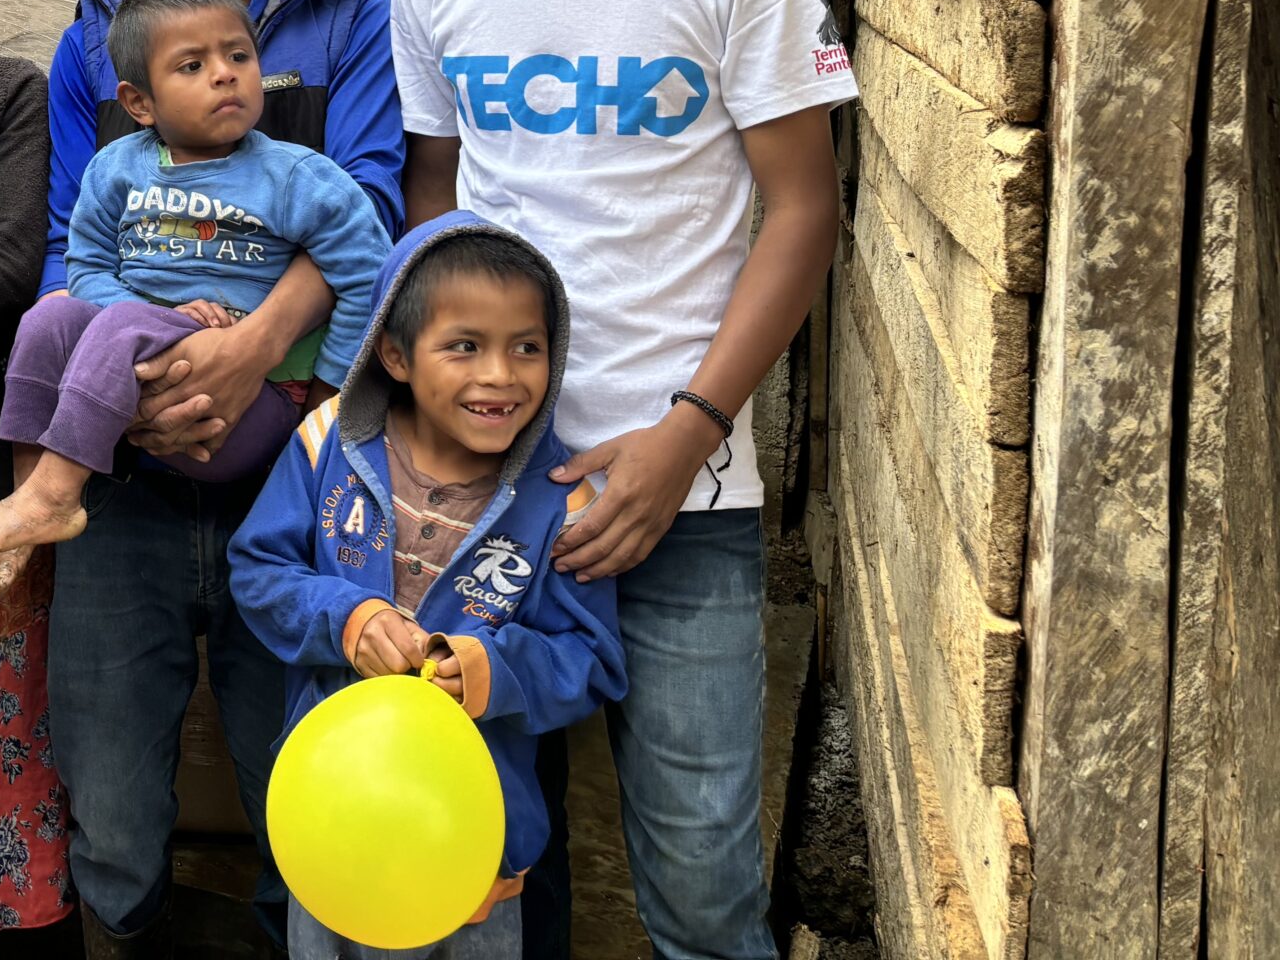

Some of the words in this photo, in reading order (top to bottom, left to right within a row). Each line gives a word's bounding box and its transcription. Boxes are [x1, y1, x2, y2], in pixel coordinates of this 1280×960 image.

[442, 53, 710, 137] TECHO
[169, 239, 264, 262] STAR
[343, 496, 365, 535] A
